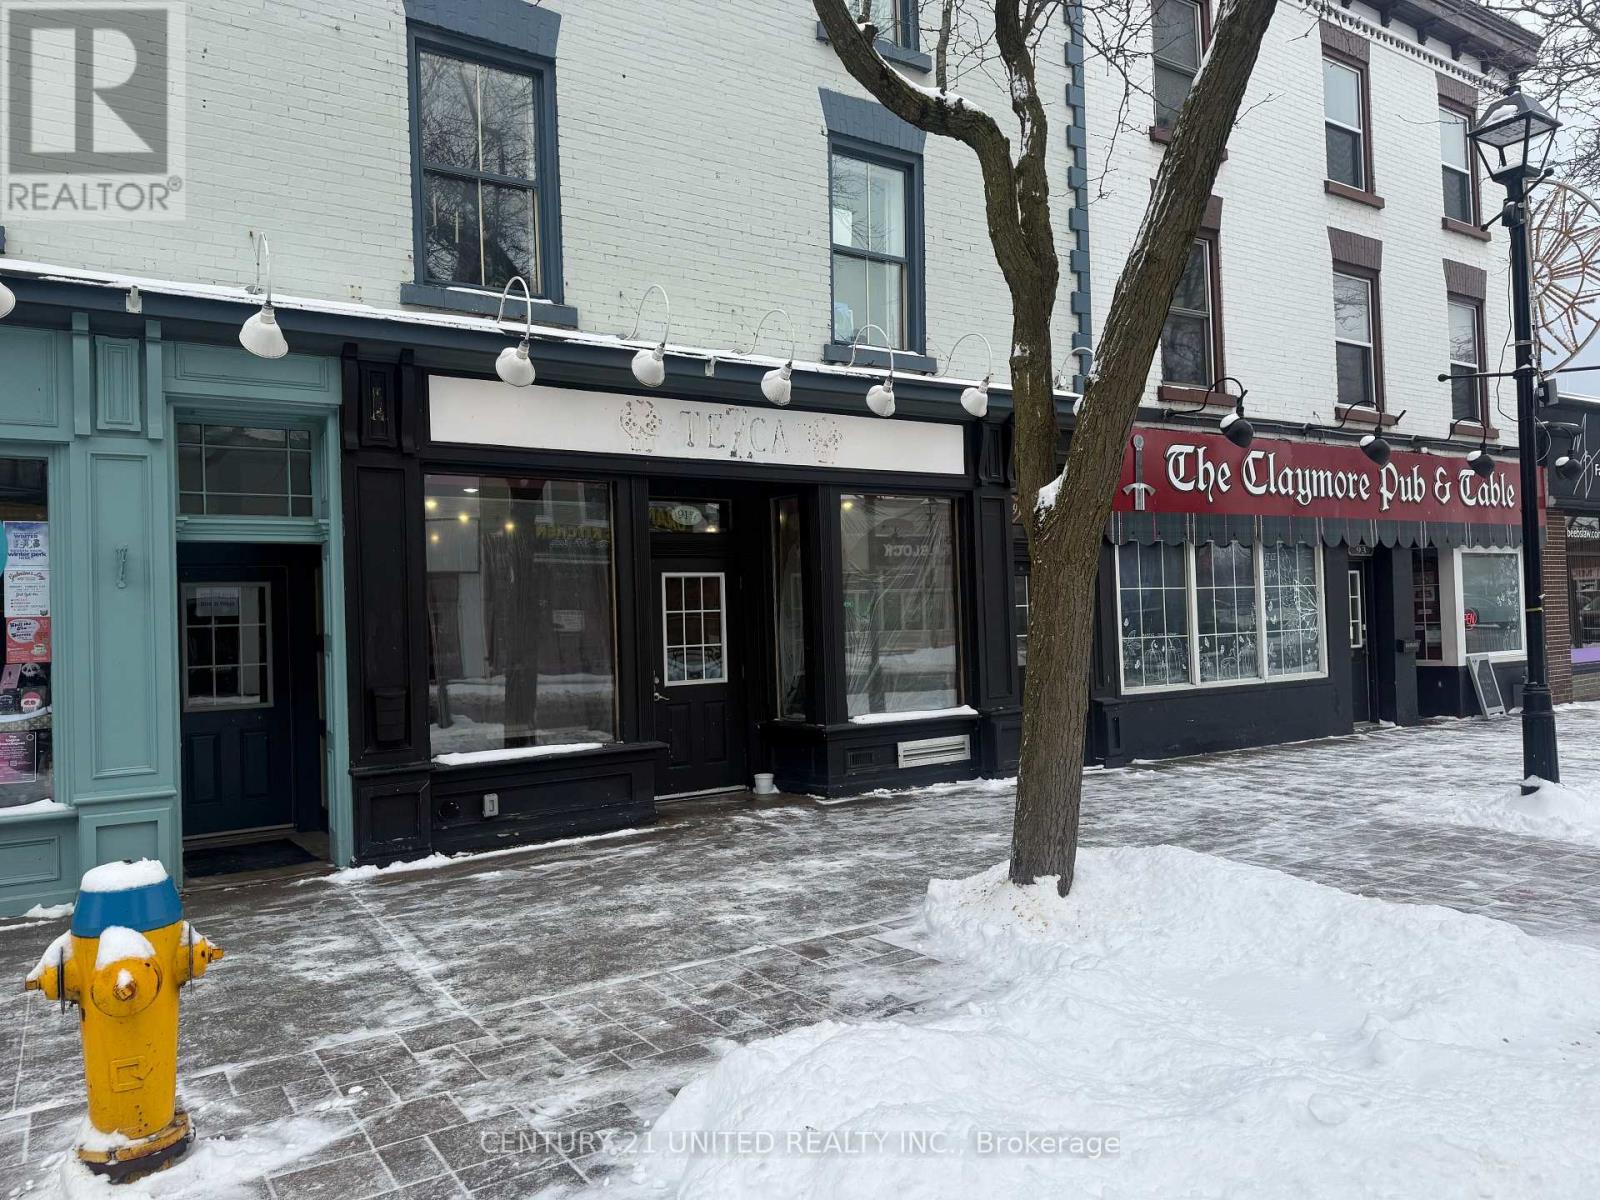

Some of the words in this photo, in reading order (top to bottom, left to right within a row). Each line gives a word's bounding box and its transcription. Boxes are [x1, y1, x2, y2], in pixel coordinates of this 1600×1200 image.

[1164, 444, 1232, 503] The
[1241, 450, 1371, 506] Claymore
[1379, 462, 1426, 511] Pub
[1434, 466, 1451, 504] &
[1458, 469, 1515, 508] Table
